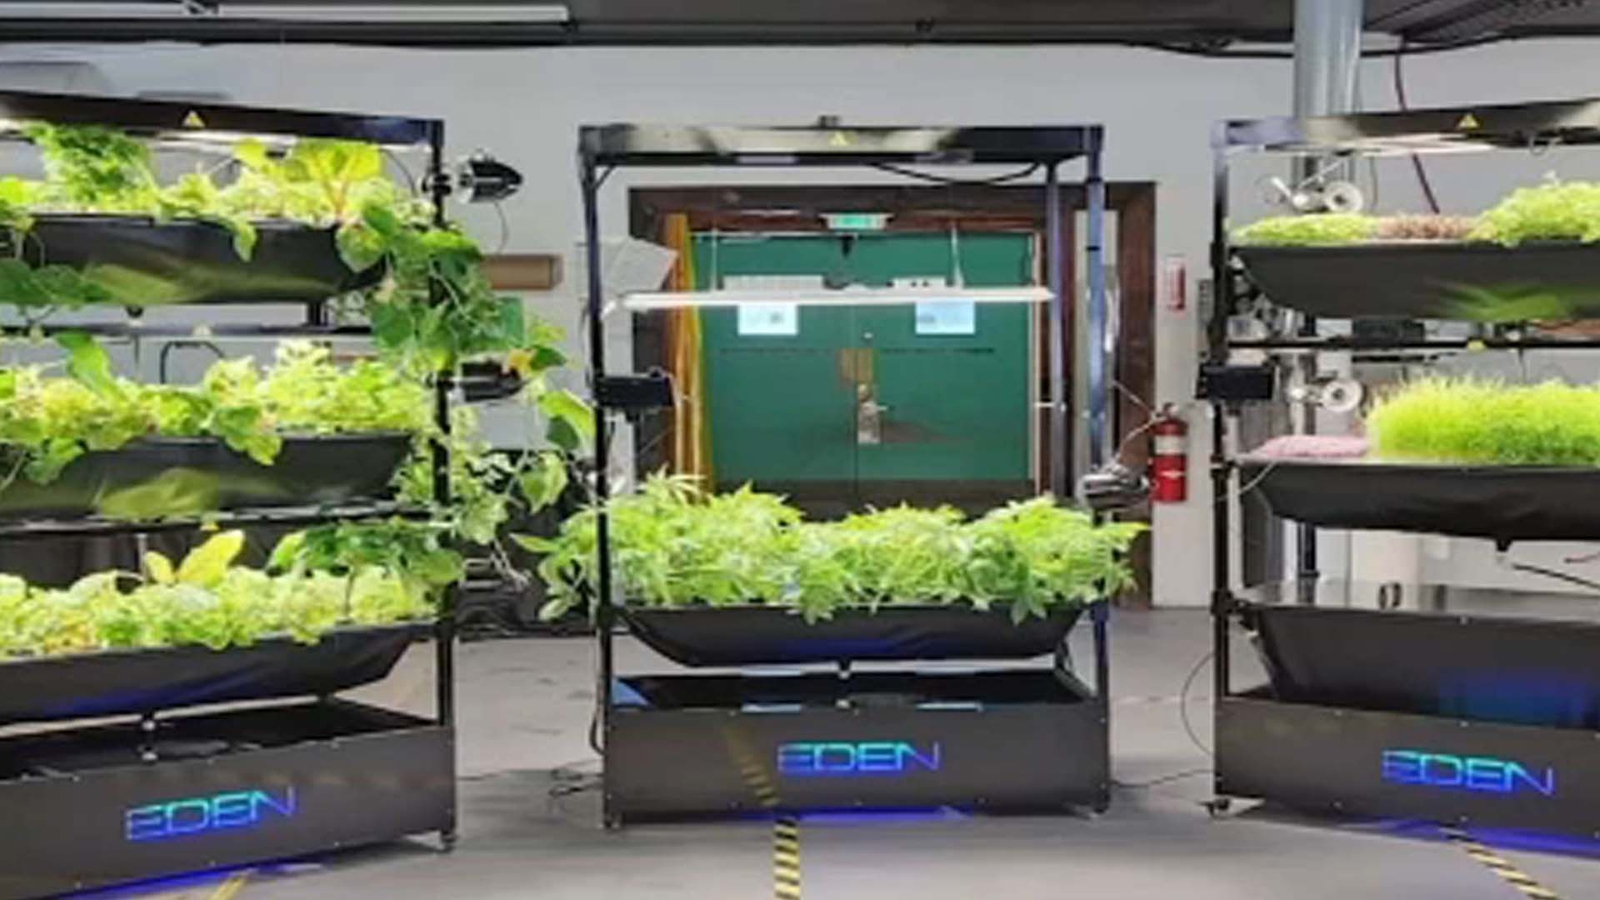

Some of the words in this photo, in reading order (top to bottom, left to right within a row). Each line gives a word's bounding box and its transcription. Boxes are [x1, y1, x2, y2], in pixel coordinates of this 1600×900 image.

[777, 741, 940, 772] EDEN
[1382, 750, 1554, 796] EDEN
[125, 786, 295, 840] EDEN
